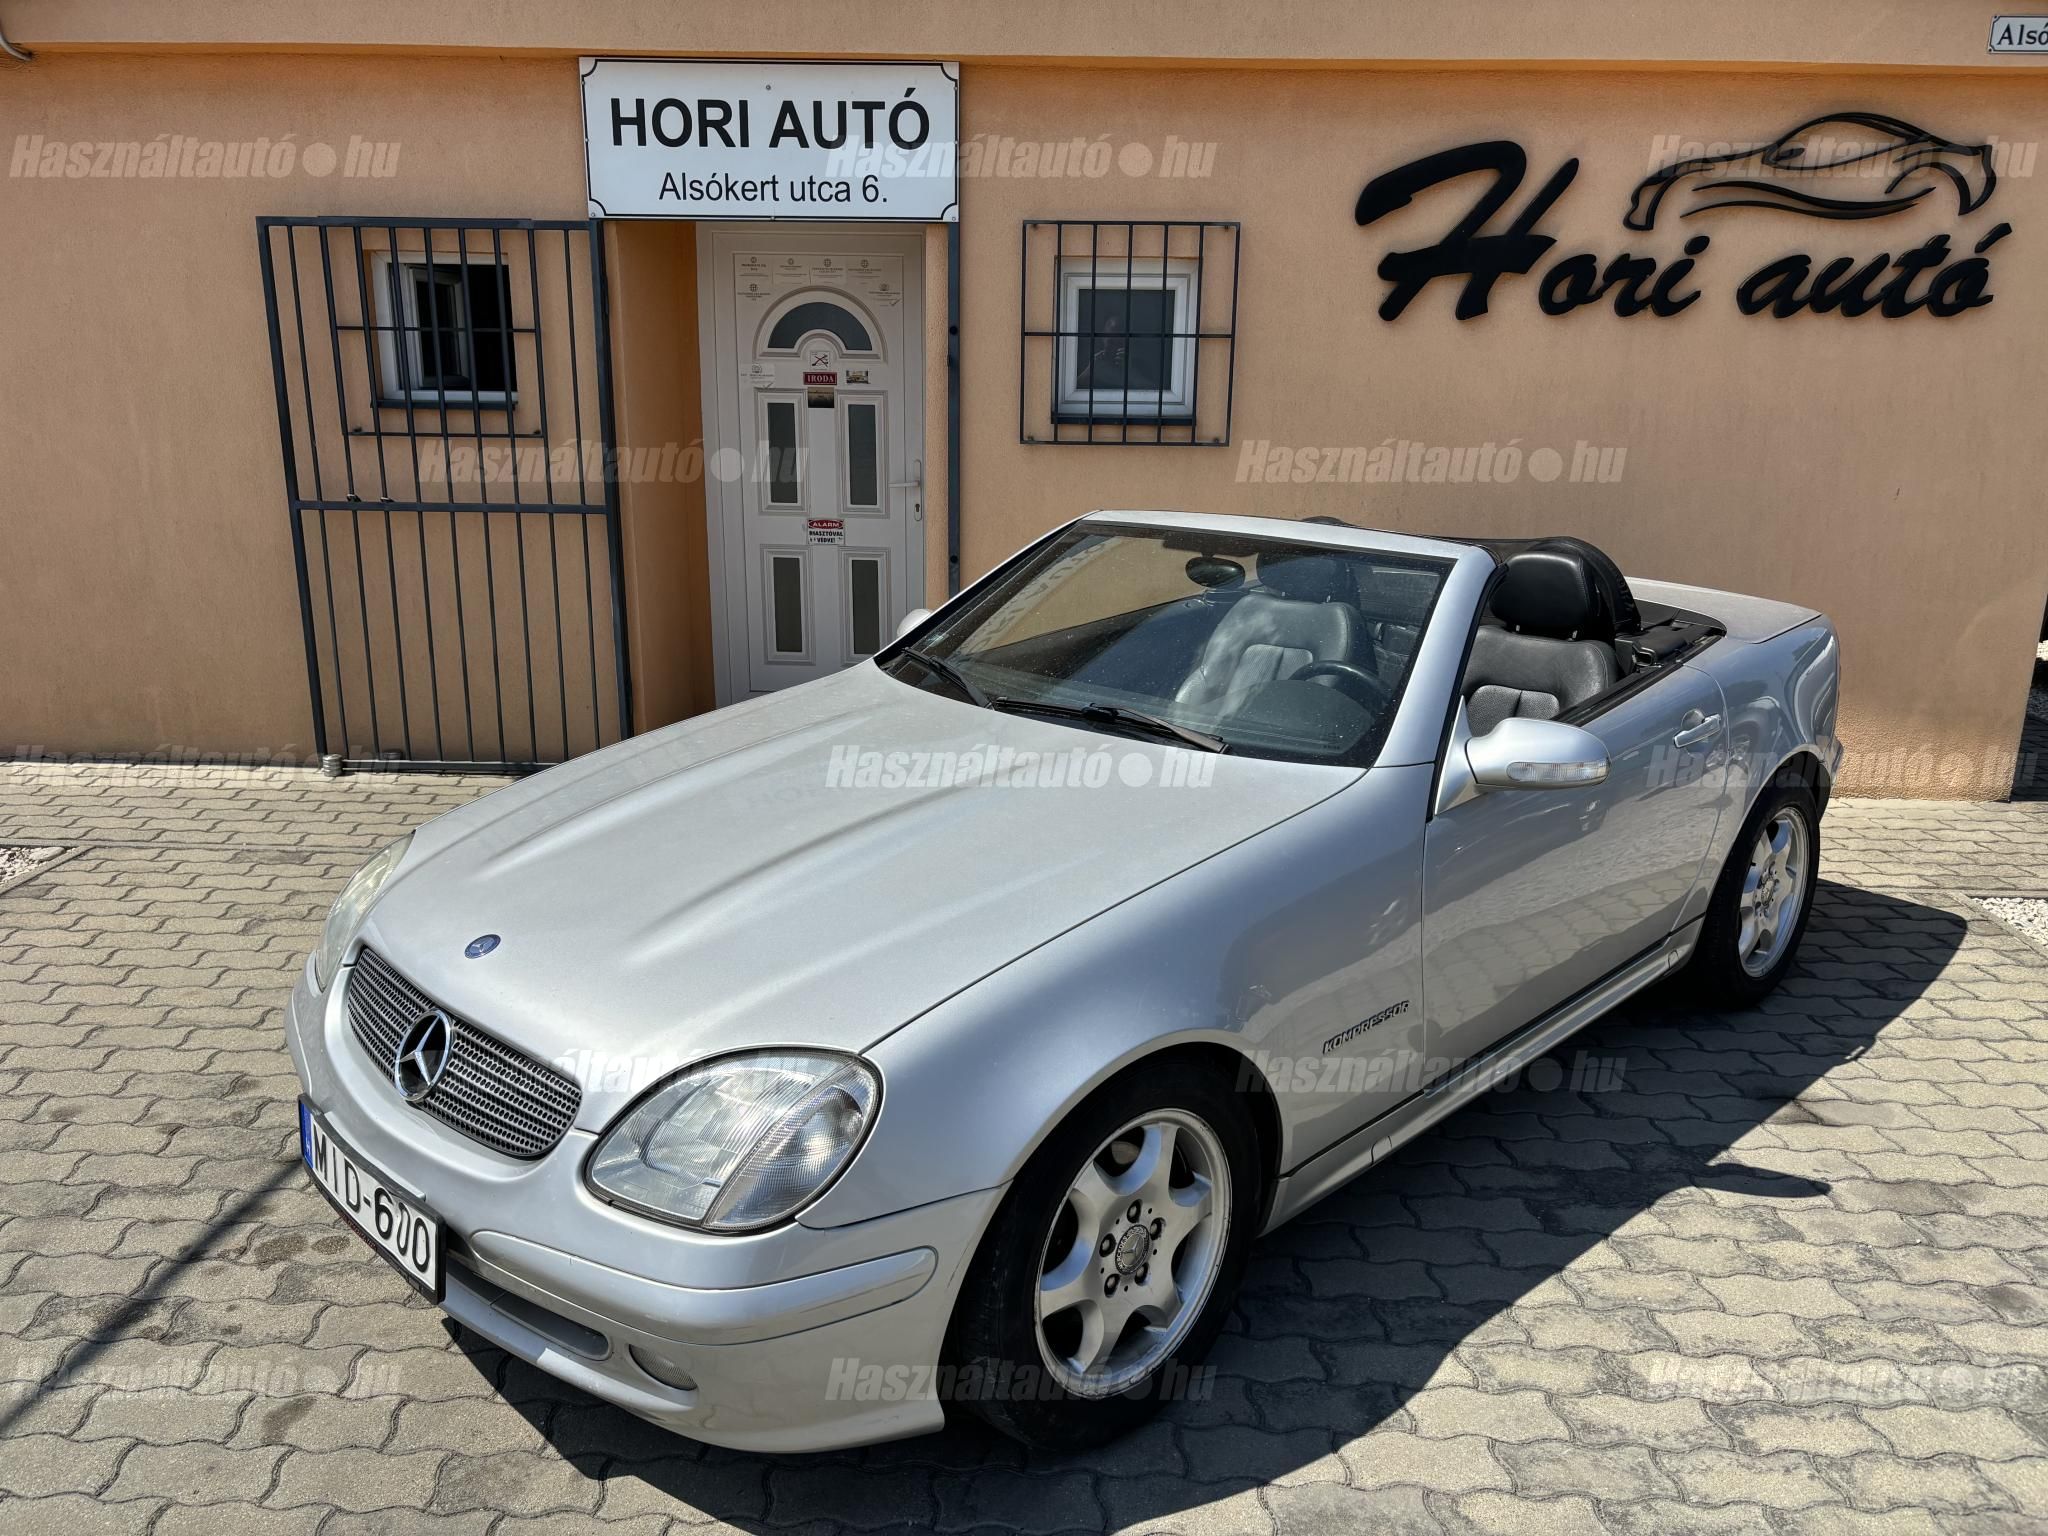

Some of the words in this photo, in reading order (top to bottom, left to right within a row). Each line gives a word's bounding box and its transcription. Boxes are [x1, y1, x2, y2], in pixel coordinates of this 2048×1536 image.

[610, 97, 750, 148] HORI
[768, 87, 931, 150] AUTÓ
[658, 171, 781, 203] Alsókert
[789, 176, 852, 204] utca
[861, 174, 890, 204] 6.
[1354, 139, 1711, 323] Hori
[1736, 221, 2014, 320] autó
[807, 374, 834, 383] IRODA
[812, 521, 840, 529] ALARM
[1322, 999, 1411, 1055] KOMPRESSOR
[312, 1123, 431, 1274] MID-600
